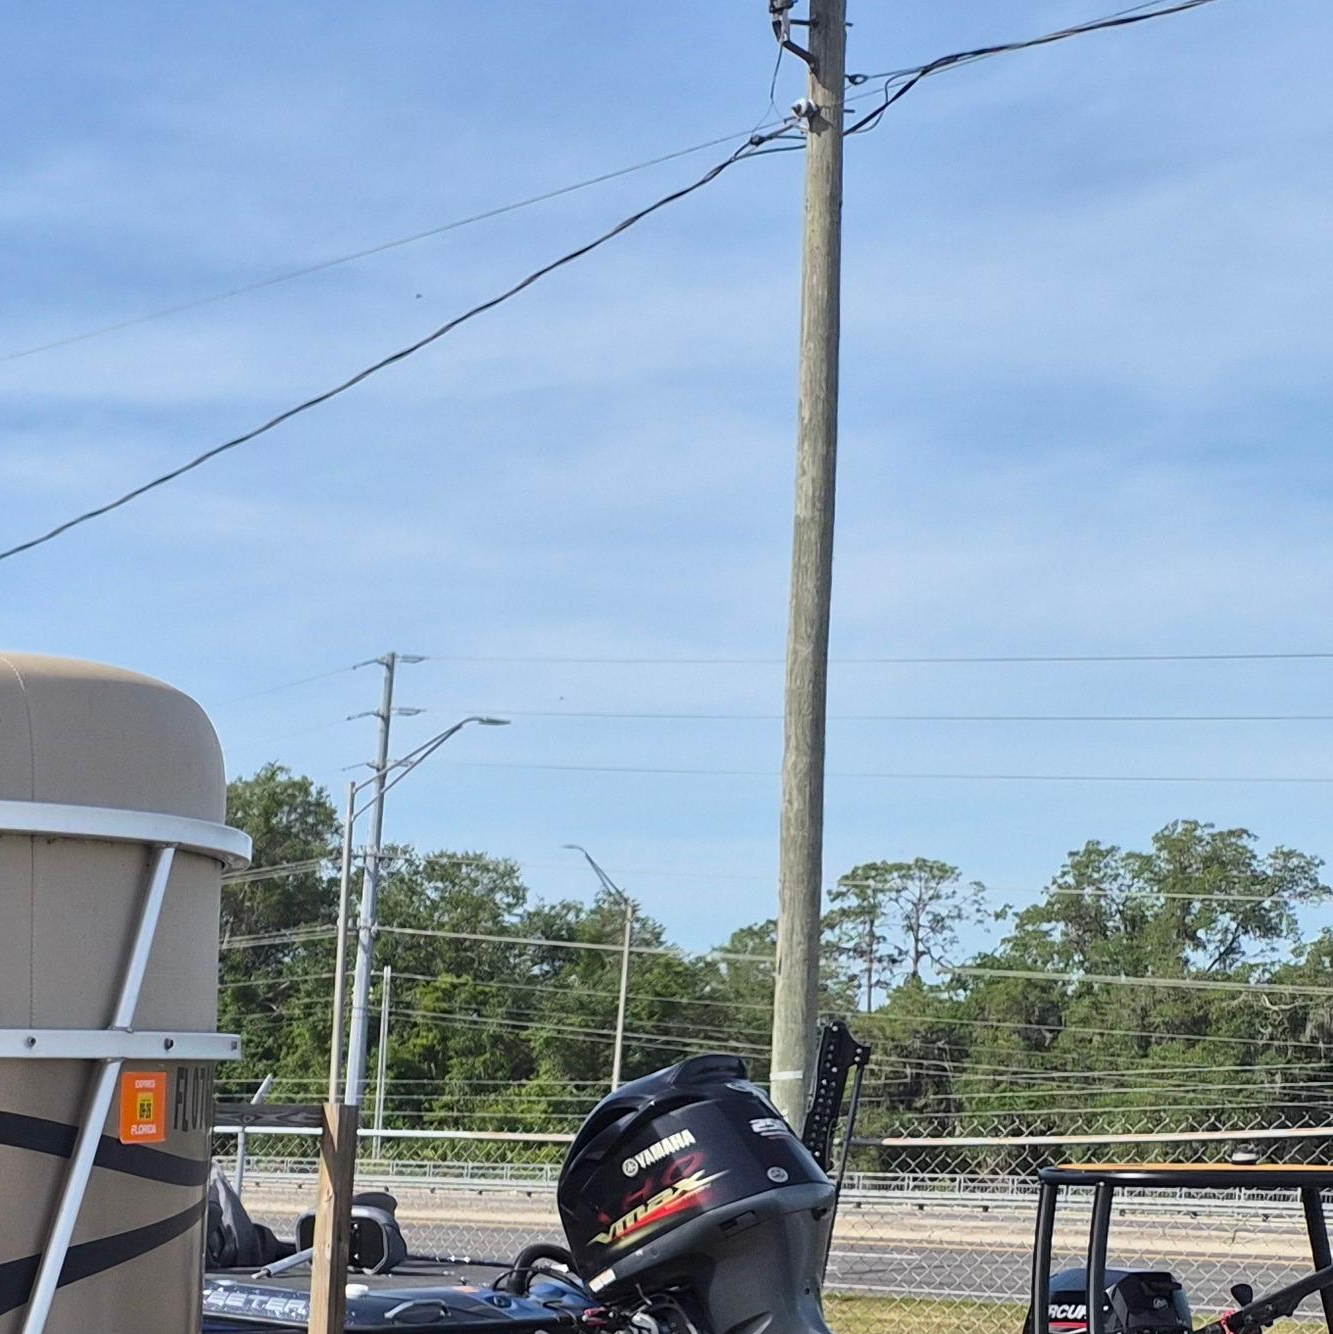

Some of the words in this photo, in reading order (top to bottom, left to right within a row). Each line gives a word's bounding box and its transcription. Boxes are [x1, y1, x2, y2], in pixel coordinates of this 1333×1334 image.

[173, 1066, 188, 1132] FL
[634, 1128, 697, 1169] YAMAHA
[1047, 1303, 1088, 1320] RCUR
